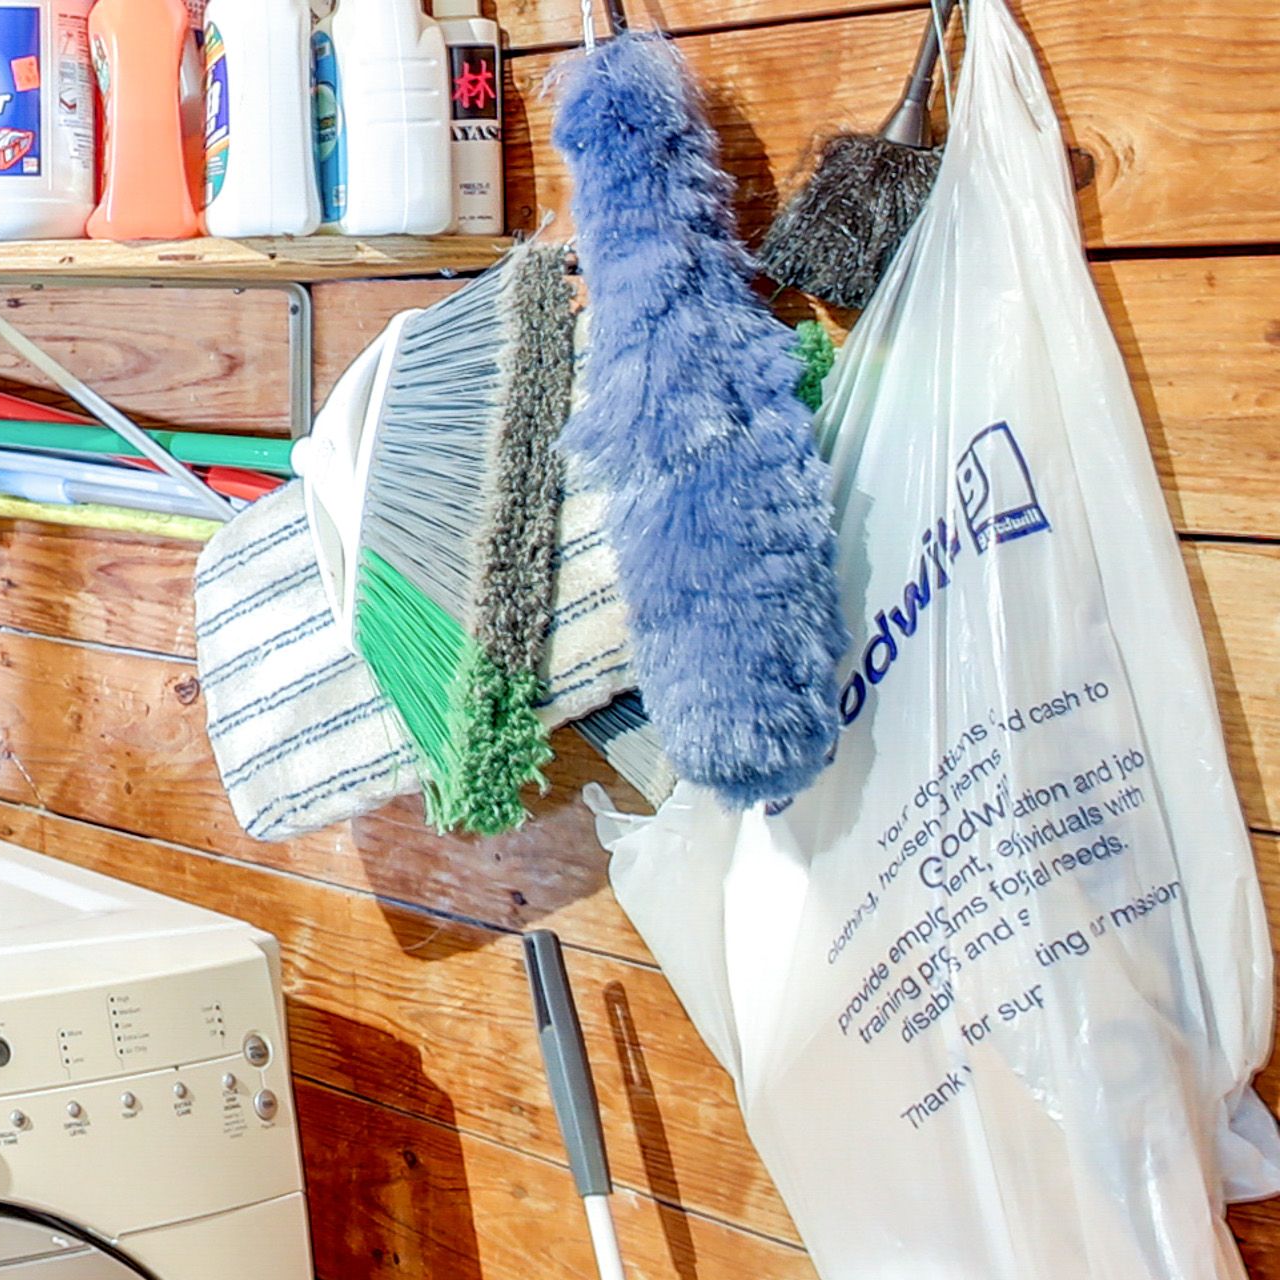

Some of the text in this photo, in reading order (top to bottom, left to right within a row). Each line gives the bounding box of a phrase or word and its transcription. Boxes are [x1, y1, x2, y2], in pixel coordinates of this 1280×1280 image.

[452, 59, 497, 109] 林
[1028, 689, 1081, 725] cash
[1084, 681, 1110, 701] to
[950, 748, 1002, 802] items
[838, 962, 890, 1036] provide
[1072, 760, 1113, 795] and
[1112, 748, 1145, 781] job
[858, 976, 922, 1045] training
[1104, 784, 1146, 817] with
[966, 915, 1015, 962] and
[900, 1071, 967, 1130] Thank
[960, 1014, 993, 1047] for
